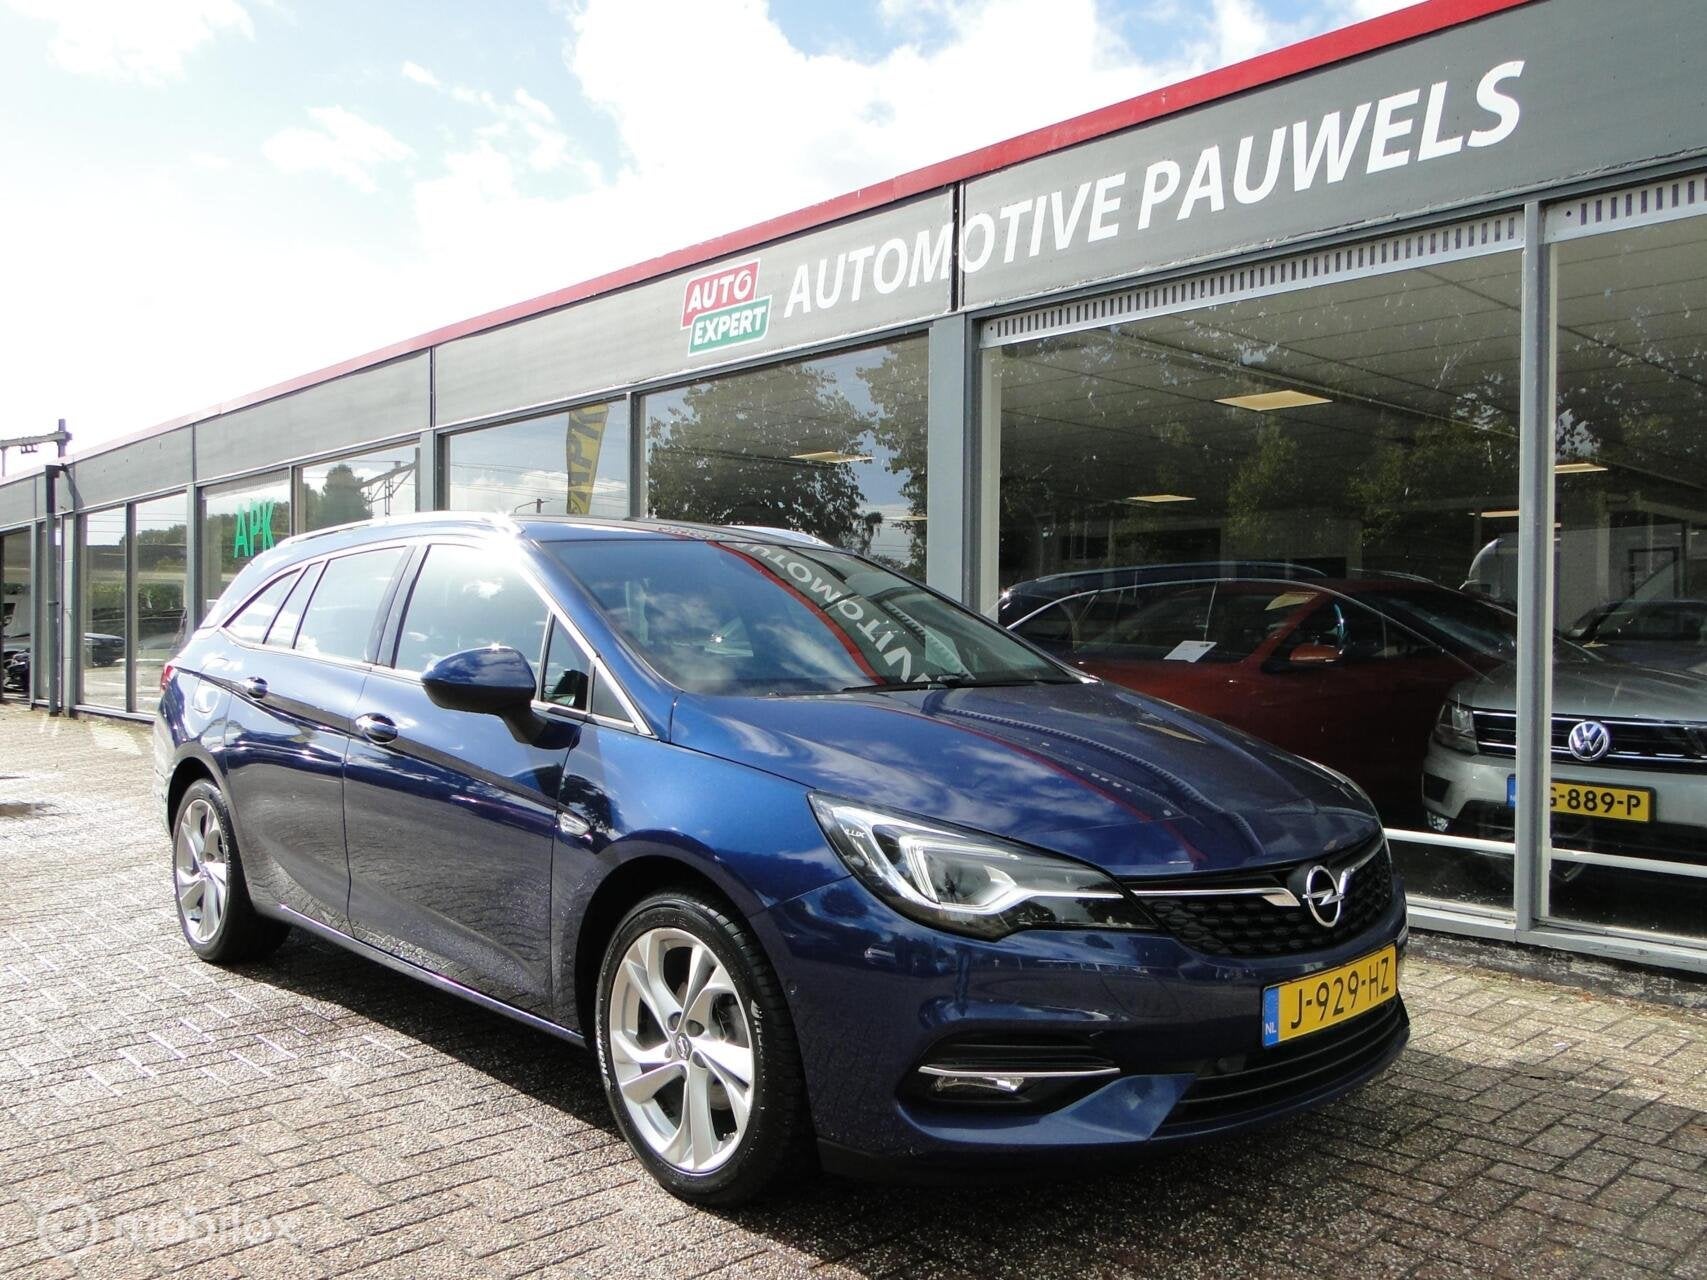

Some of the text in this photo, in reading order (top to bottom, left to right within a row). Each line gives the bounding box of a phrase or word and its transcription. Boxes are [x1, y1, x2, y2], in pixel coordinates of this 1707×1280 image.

[783, 60, 1525, 318] AUTOMOTIVE PAUWELS
[687, 269, 752, 314] AUTO
[693, 306, 767, 346] EXPERT
[233, 499, 275, 558] APK
[1290, 956, 1389, 1030] J-929-HZ
[1265, 1023, 1277, 1035] NL
